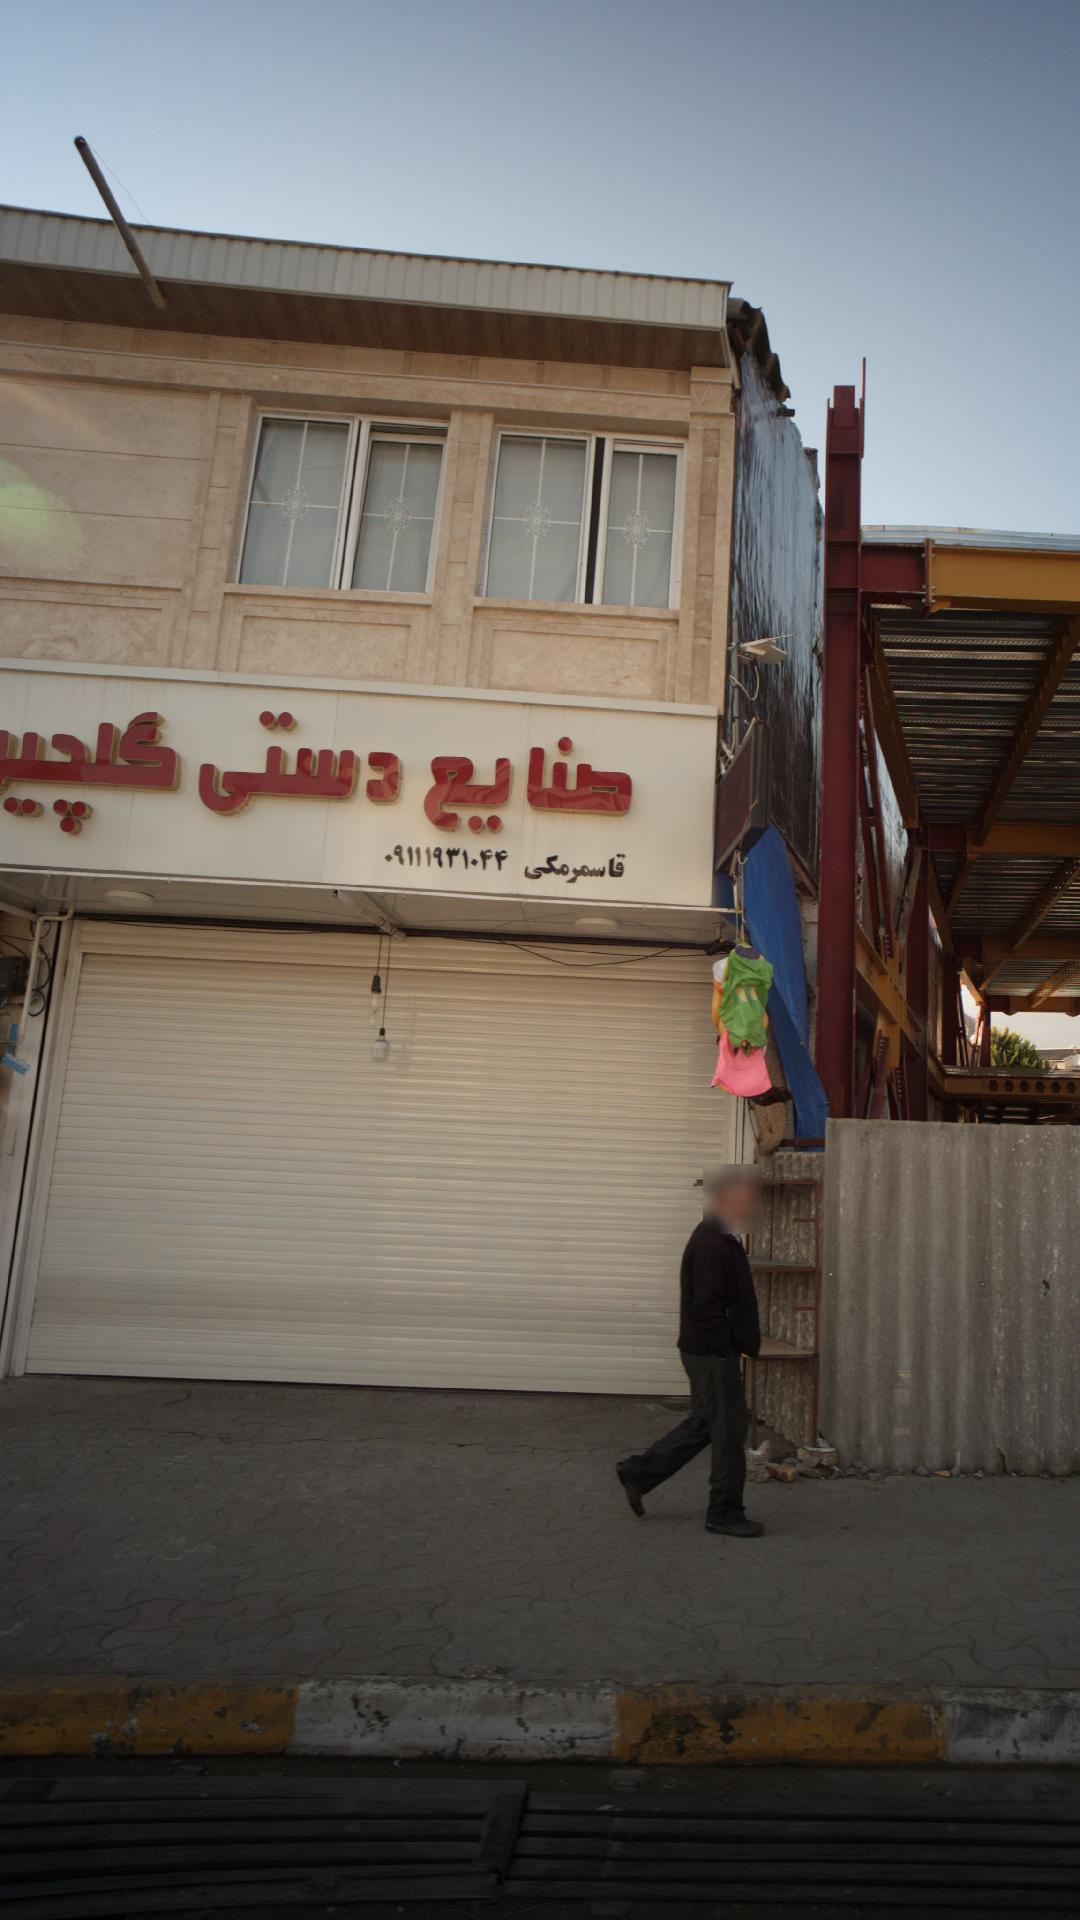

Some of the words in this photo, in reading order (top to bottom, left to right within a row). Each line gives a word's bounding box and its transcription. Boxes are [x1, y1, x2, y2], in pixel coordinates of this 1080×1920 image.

[199, 710, 404, 816] دستی
[423, 736, 632, 834] صنایع
[384, 844, 509, 871] ۰۹۱۱۱۹۳۱۰۴۴
